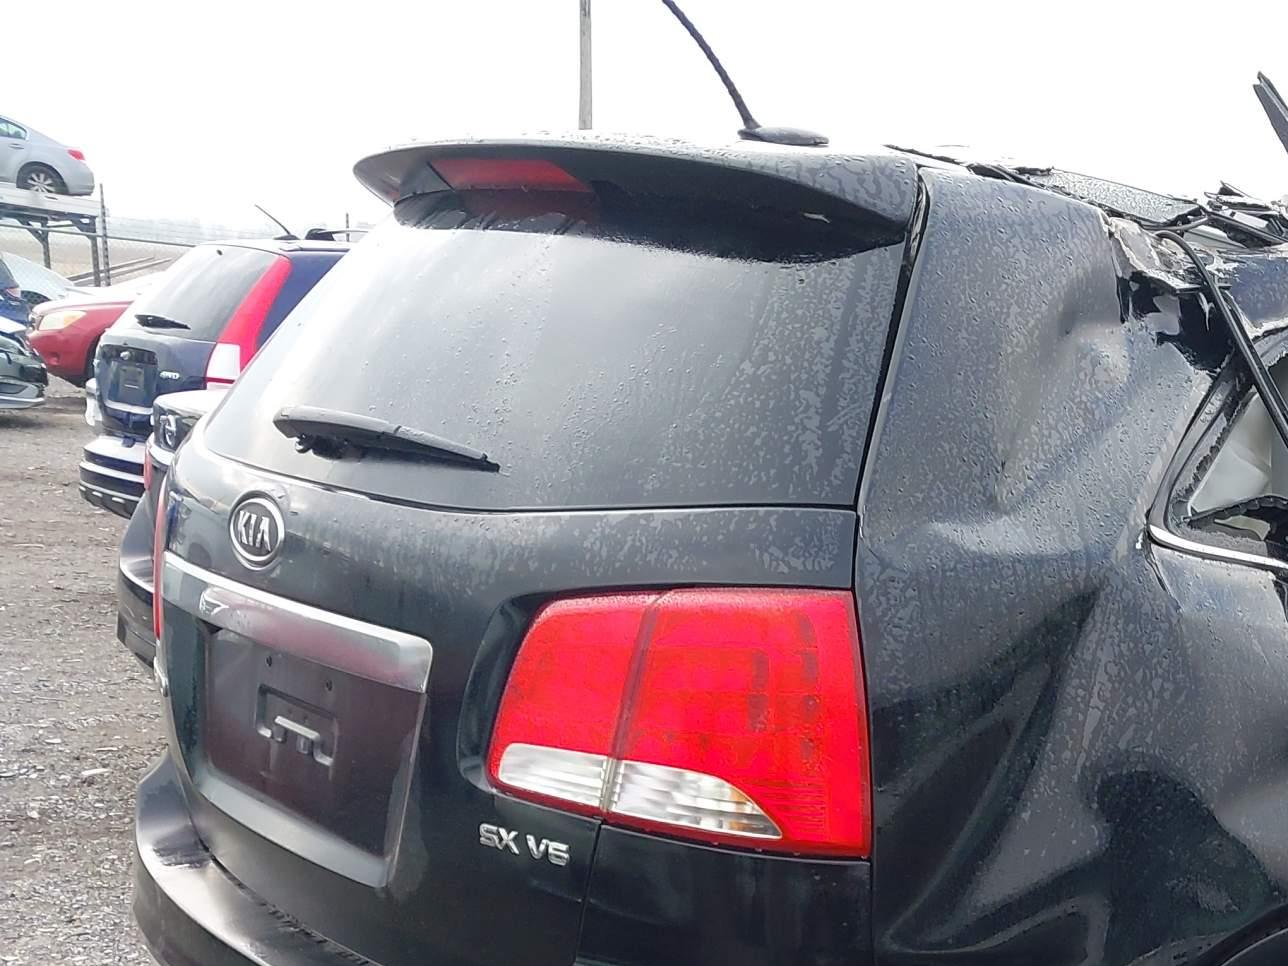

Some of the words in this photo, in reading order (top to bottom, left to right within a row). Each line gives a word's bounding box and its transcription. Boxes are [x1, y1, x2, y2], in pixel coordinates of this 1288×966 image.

[237, 510, 272, 552] KIA
[479, 823, 520, 855] SX
[526, 834, 570, 867] V6
